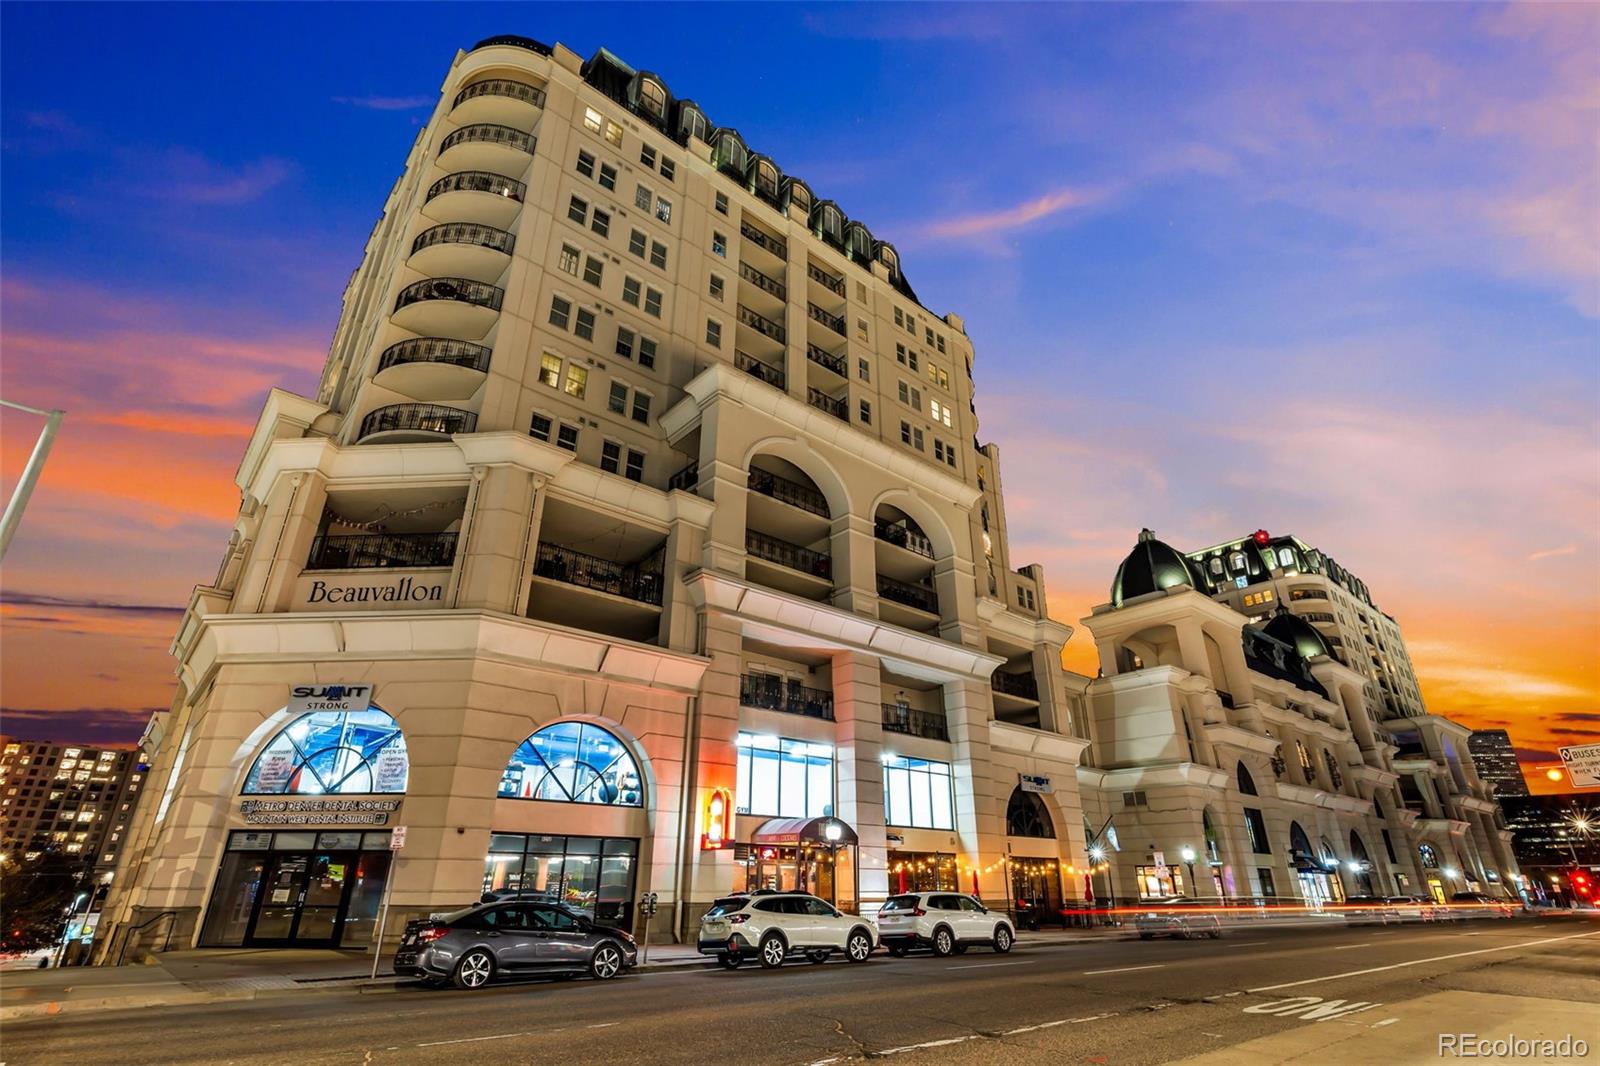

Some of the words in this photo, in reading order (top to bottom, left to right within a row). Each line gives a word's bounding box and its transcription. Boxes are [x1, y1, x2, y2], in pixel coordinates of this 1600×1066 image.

[307, 577, 442, 603] Beauvallon
[306, 702, 349, 710] STRONG
[254, 801, 286, 811] METRO
[287, 801, 323, 811] DENVER
[324, 801, 358, 811] DENTAL
[359, 801, 400, 811] SOCIETY
[246, 813, 287, 824] MOUNTAIN
[288, 813, 307, 824] WEST
[308, 814, 337, 824] DENTAL
[337, 814, 373, 824] INSTITUTE
